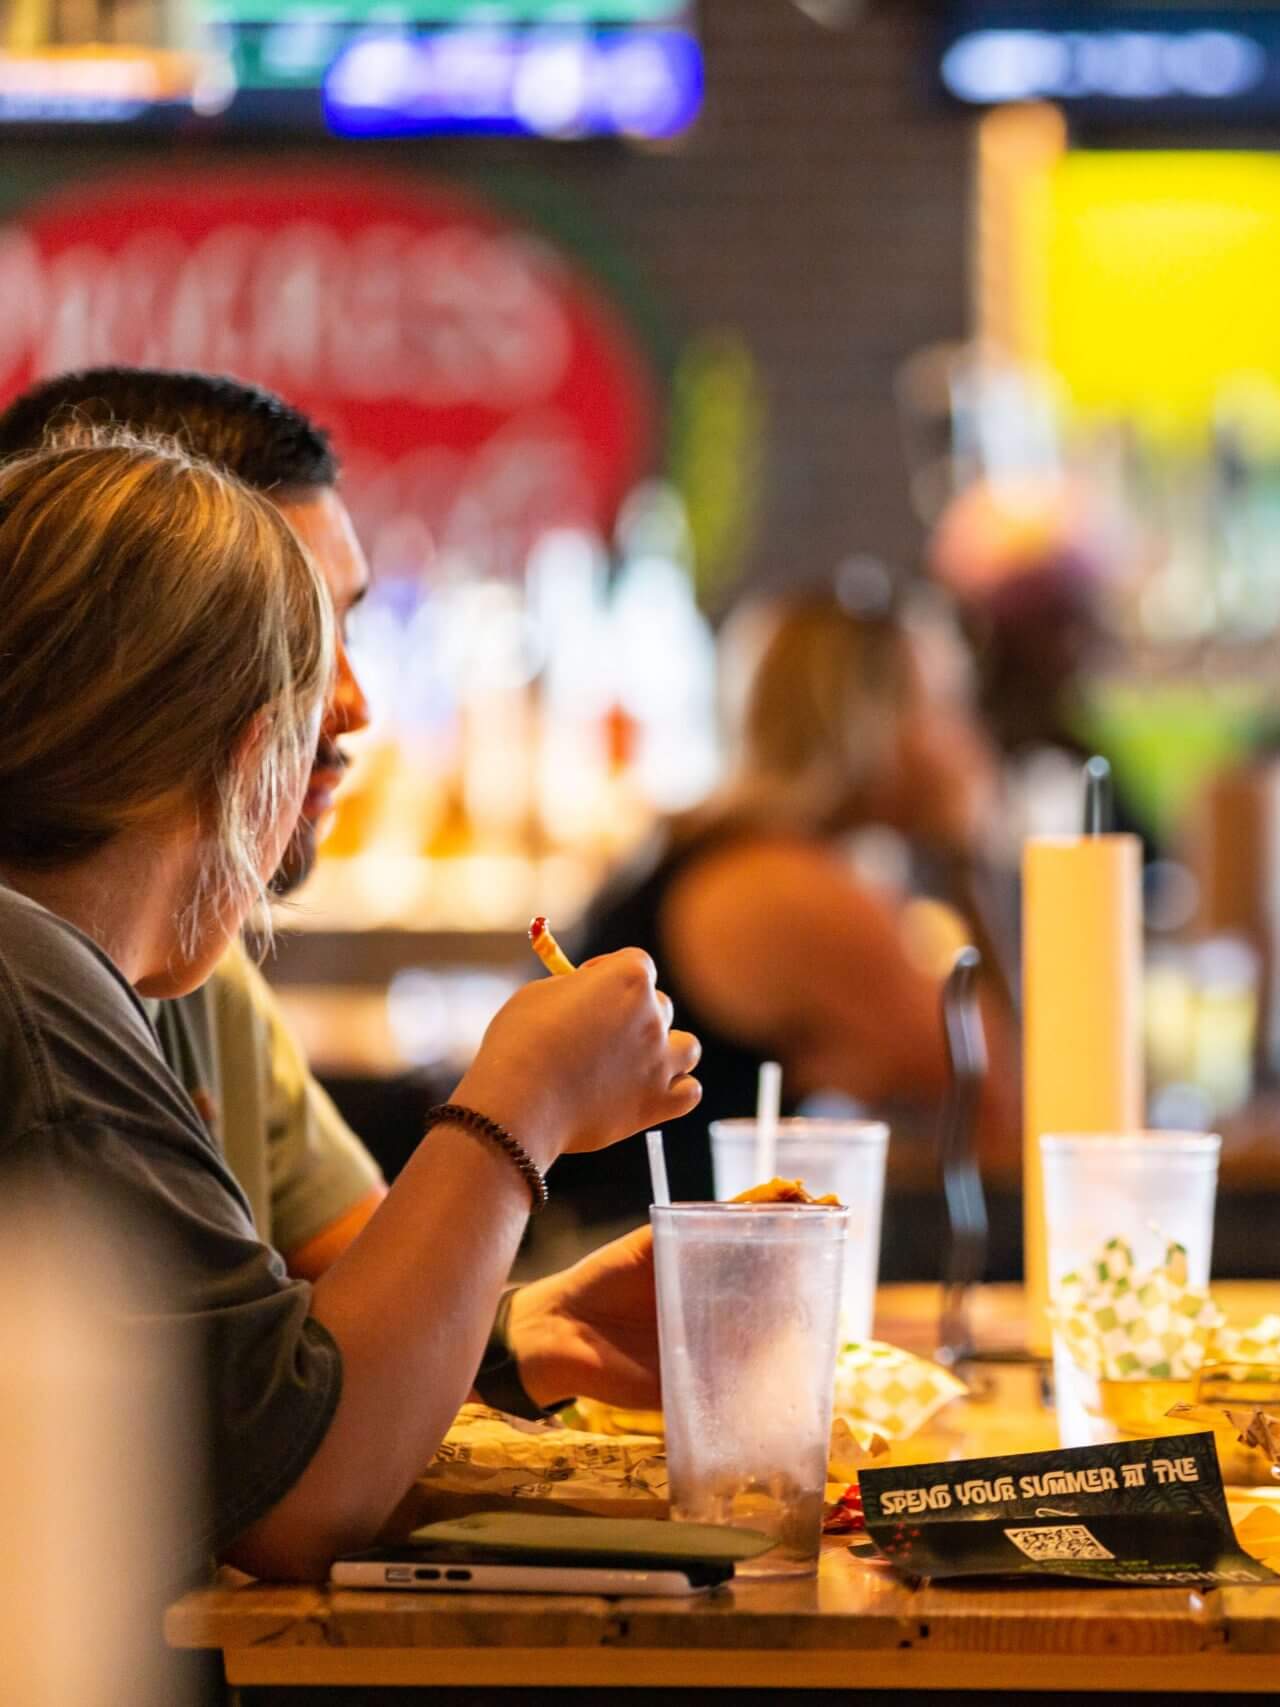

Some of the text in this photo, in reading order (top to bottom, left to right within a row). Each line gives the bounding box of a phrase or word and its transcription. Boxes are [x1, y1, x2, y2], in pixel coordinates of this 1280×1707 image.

[880, 1457, 1199, 1515] SPEND YOUR SUMMER AT THE
